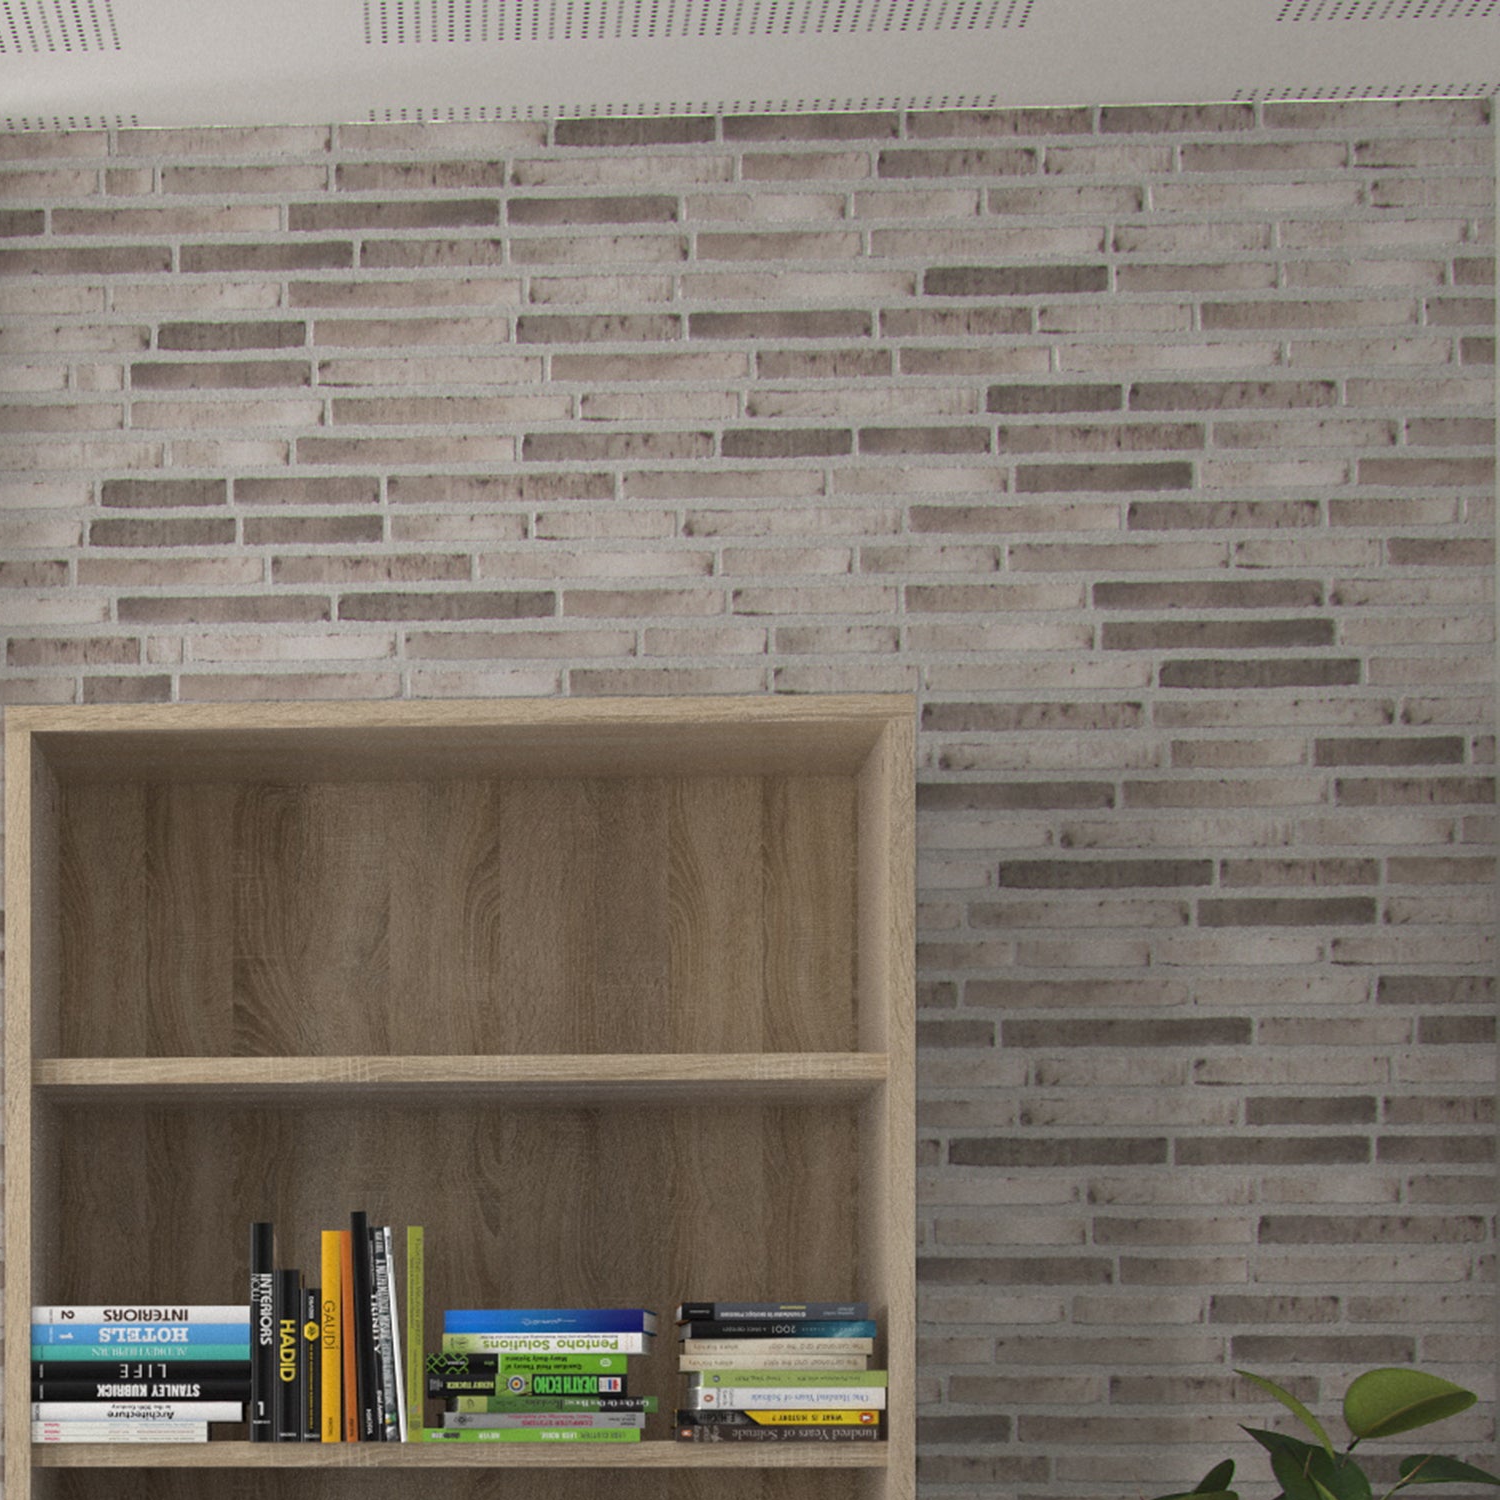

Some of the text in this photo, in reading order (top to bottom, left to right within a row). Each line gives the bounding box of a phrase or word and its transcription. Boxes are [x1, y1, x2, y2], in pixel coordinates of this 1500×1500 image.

[60, 1310, 75, 1319] 2
[103, 1309, 188, 1322] INTERIORS
[260, 1273, 273, 1346] INTERIORS
[99, 1327, 189, 1342] HOTELS
[279, 1319, 296, 1382] HADID
[482, 1339, 619, 1351] Pentaho Solutions
[119, 1363, 167, 1378] LIFE
[96, 1384, 201, 1397] STANLEY KUBRICK
[533, 1375, 598, 1394] DEATH ECHO
[732, 1429, 778, 1441] Solitude
[780, 1429, 795, 1440] of
[799, 1428, 829, 1440] Years
